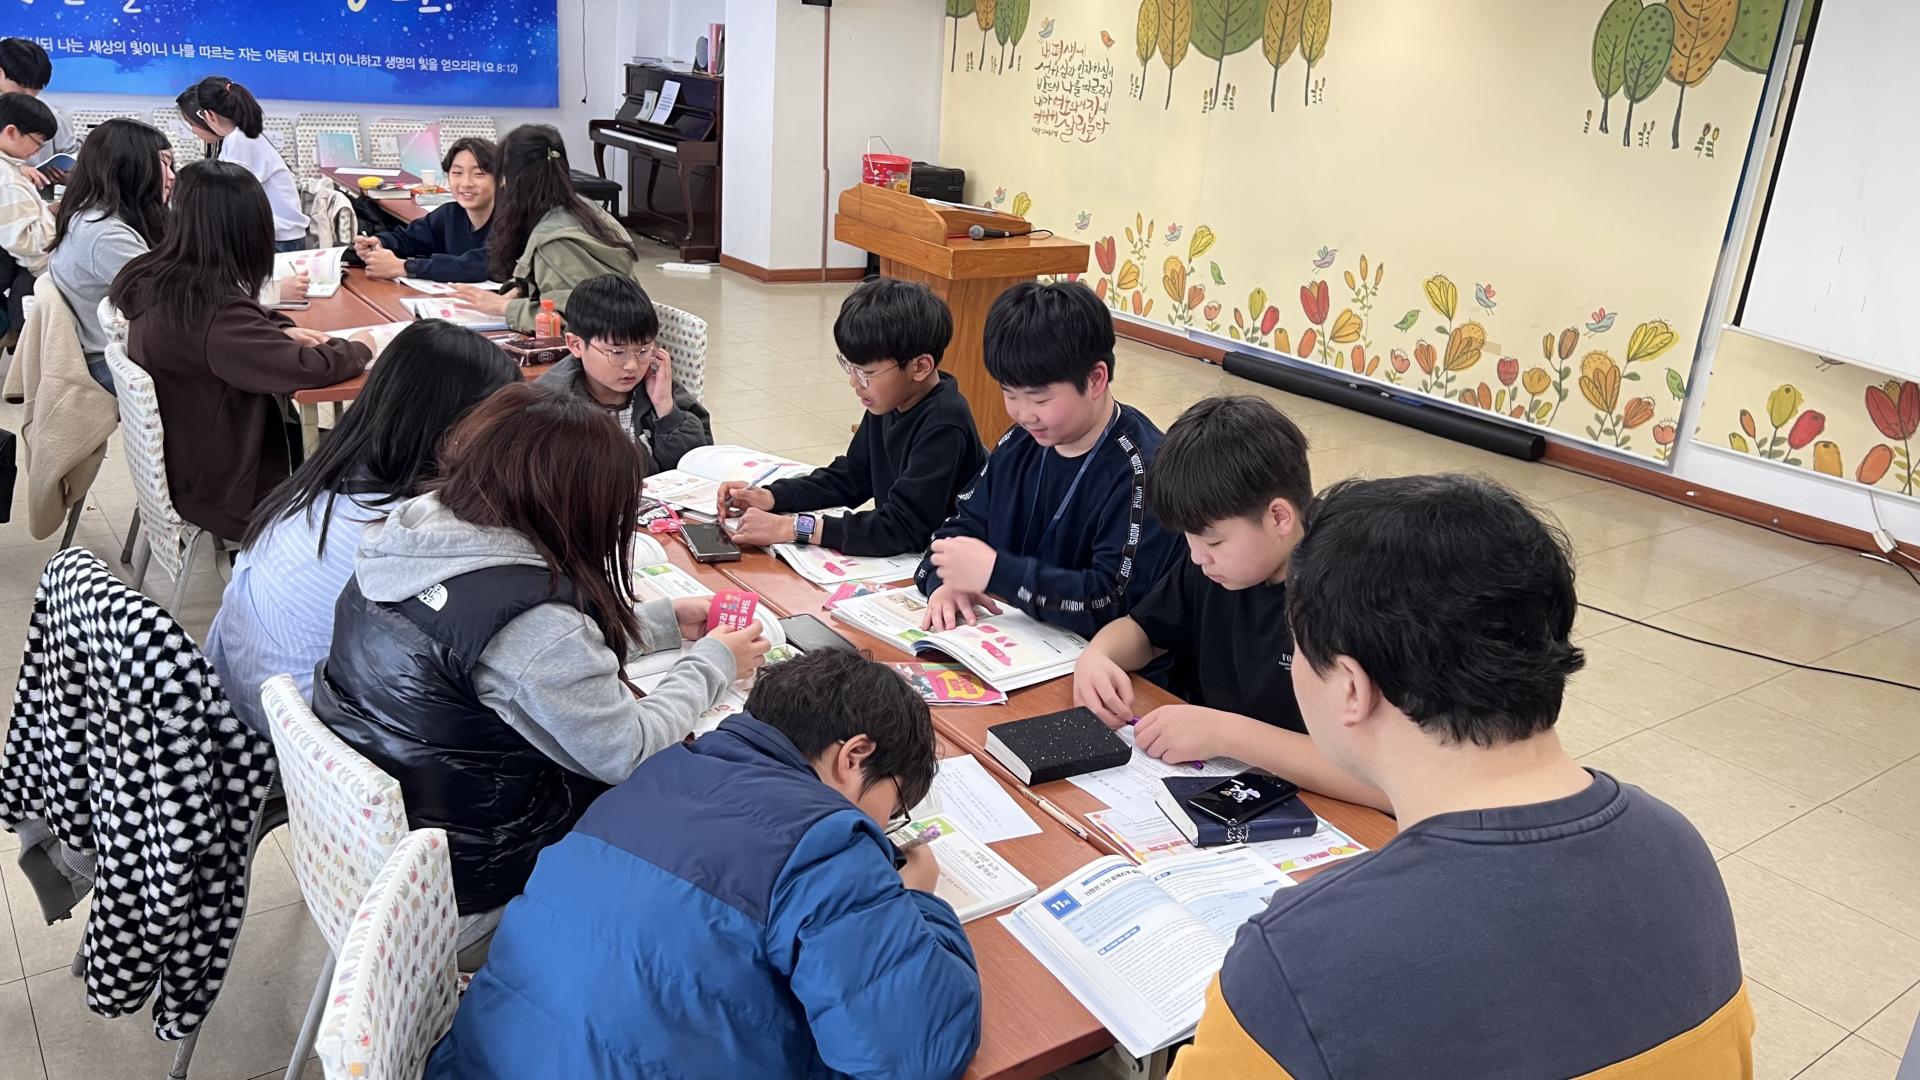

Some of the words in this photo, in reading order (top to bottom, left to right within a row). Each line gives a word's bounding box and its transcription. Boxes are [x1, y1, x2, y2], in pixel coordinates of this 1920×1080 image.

[58, 39, 84, 53] 나는
[88, 40, 126, 54] 세상의
[130, 40, 168, 57] 빛이니
[172, 44, 195, 58] 나를
[199, 46, 234, 59] 따르는
[238, 47, 262, 61] 자는
[265, 49, 299, 63] 어둠에
[303, 52, 336, 66] 다니지
[338, 53, 382, 67] 아니하고
[385, 56, 416, 70] 생명의
[418, 56, 438, 71] 빛을
[441, 59, 480, 73] 얻으리라
[1062, 80, 1081, 97] 나를
